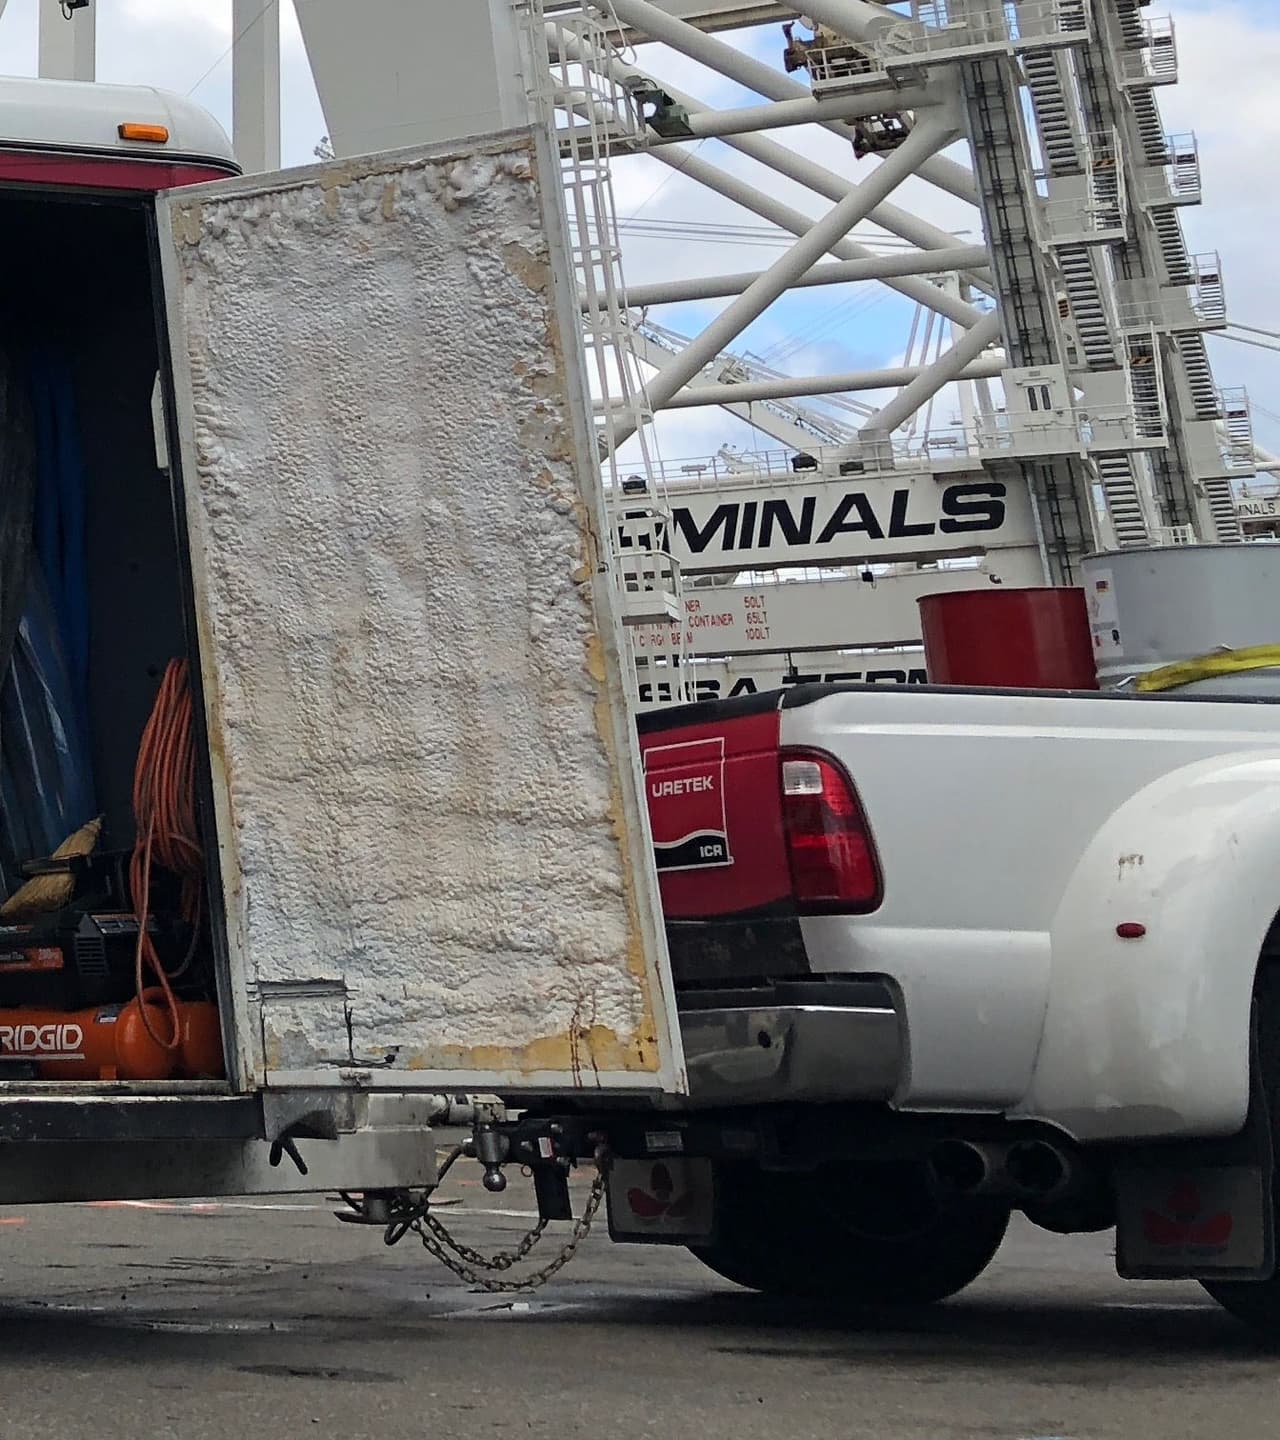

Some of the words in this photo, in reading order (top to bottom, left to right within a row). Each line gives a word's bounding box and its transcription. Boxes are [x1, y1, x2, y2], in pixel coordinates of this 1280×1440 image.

[688, 613, 734, 628] CONTAINER
[746, 612, 767, 625] 65LT
[652, 775, 714, 797] URETEK
[700, 845, 723, 857] ICR
